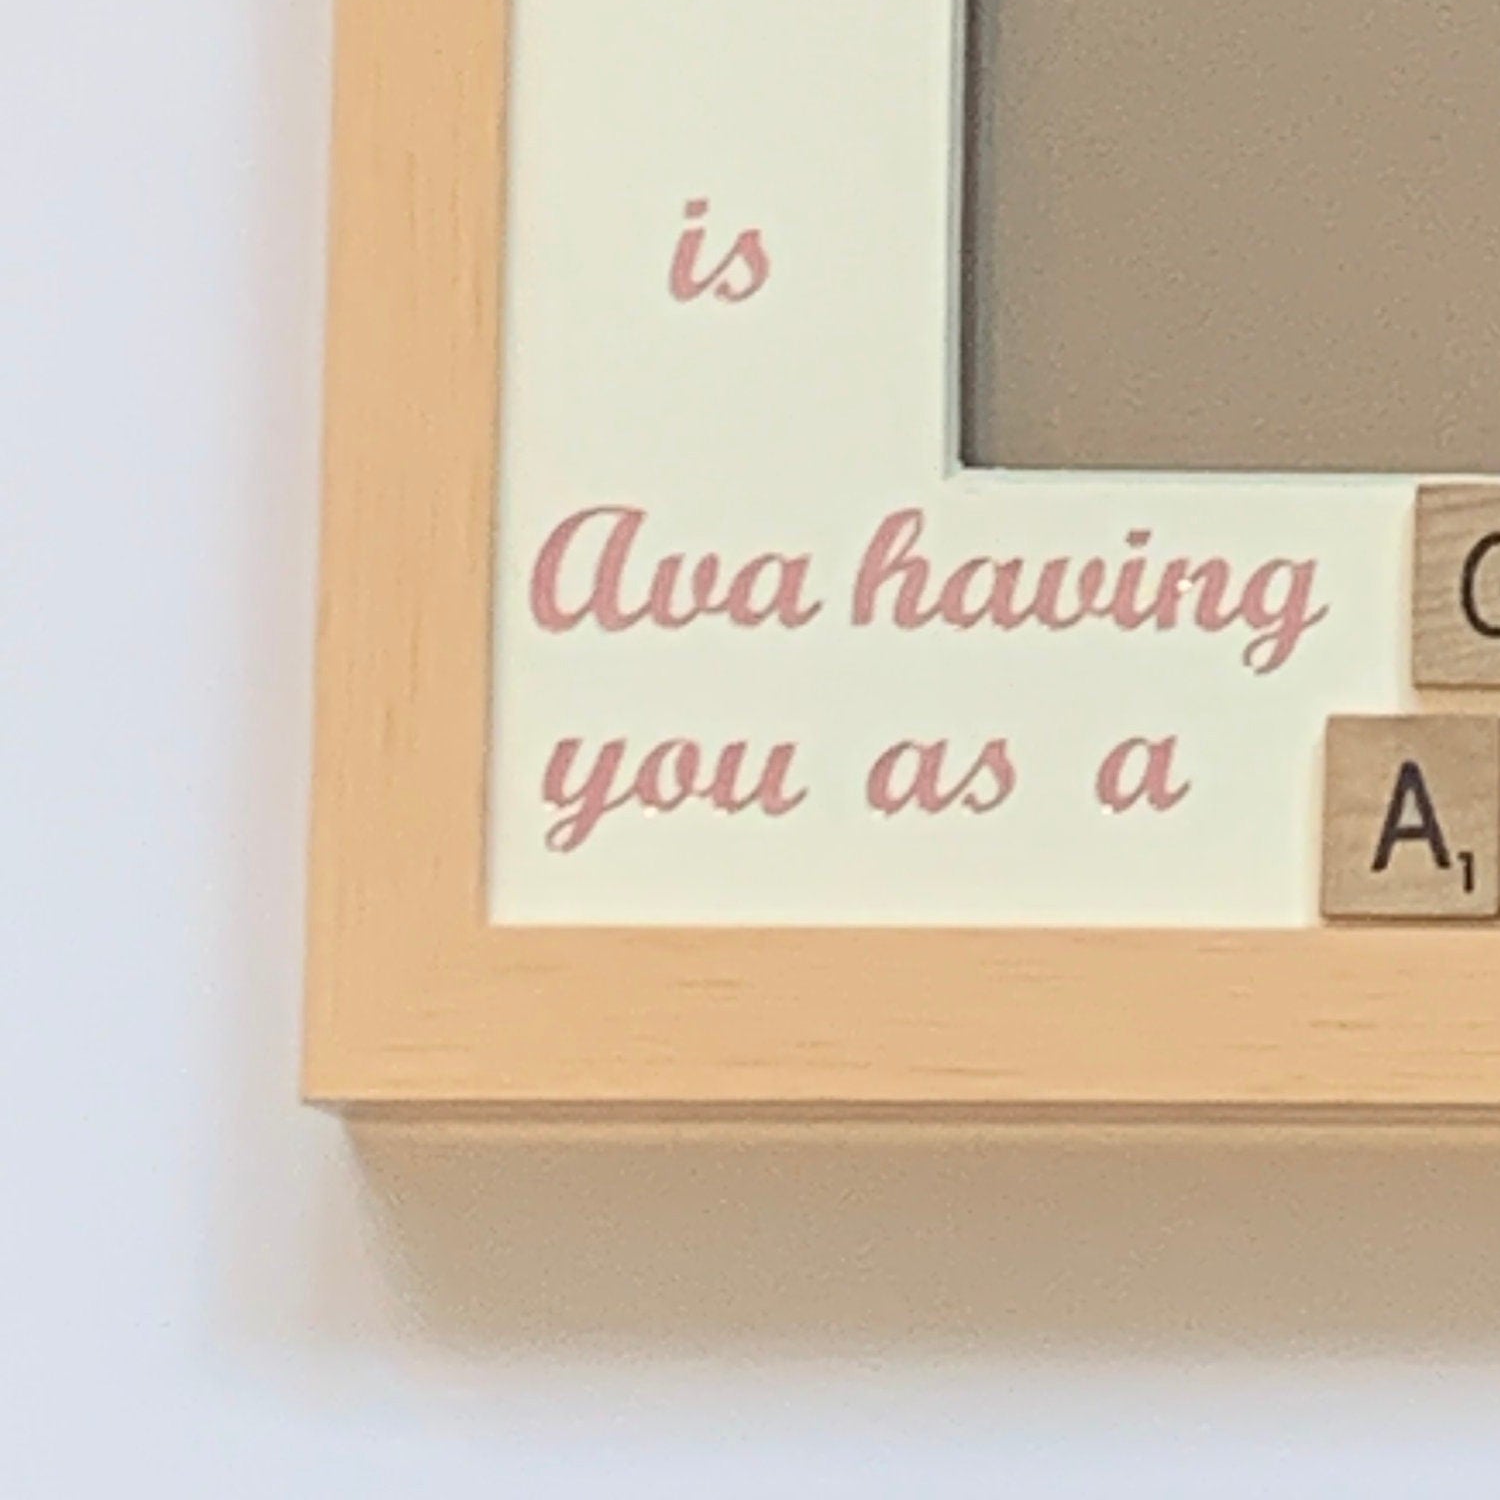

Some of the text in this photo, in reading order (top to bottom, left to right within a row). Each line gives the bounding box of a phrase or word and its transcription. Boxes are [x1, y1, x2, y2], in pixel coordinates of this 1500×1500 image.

[667, 198, 771, 304] is
[528, 506, 1330, 676] Ava having
[540, 735, 1192, 854] you as a
